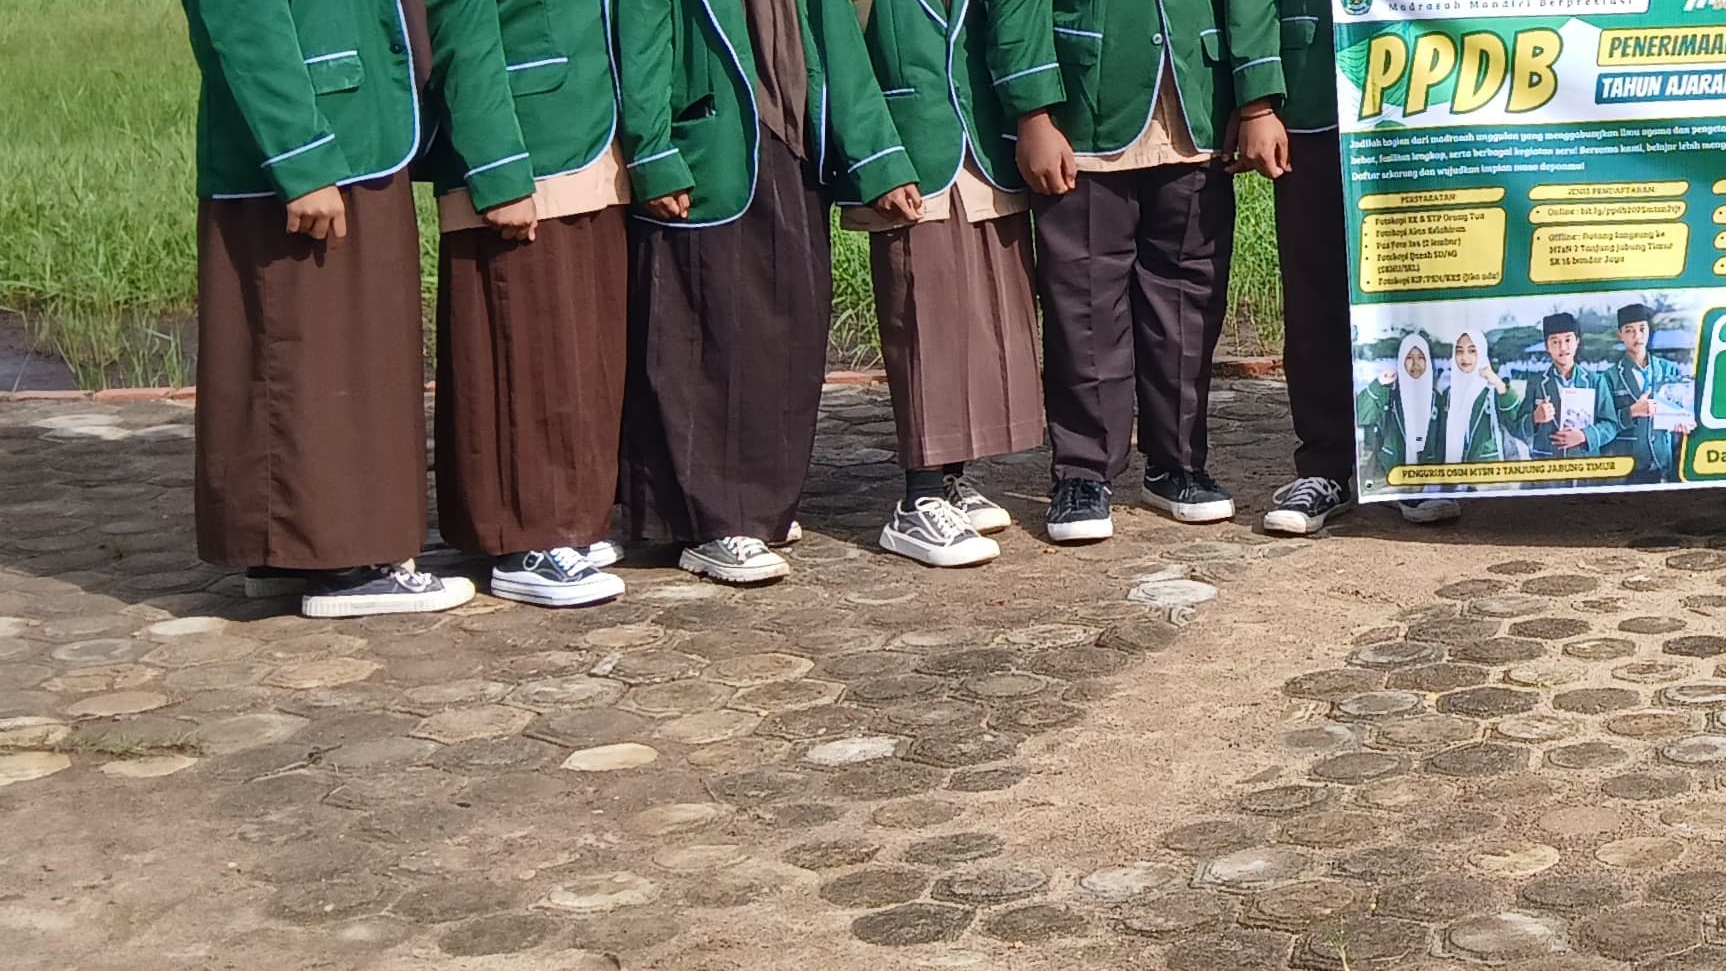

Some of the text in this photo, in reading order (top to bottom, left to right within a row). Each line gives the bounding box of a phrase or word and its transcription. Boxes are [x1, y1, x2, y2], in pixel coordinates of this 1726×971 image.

[1388, 0, 1461, 11] Madrasah
[1358, 27, 1563, 120] PPDB
[1602, 75, 1661, 101] TAHUN
[1350, 138, 1382, 149] Jadilah
[1410, 136, 1430, 146] dari
[1430, 134, 1474, 145] madrasah
[1476, 132, 1520, 145] unggulan
[1520, 133, 1543, 143] yang
[1544, 127, 1618, 142] menggabungkan
[1642, 127, 1672, 138] agama
[1672, 124, 1690, 134] dan
[1449, 149, 1472, 160] serta
[1472, 147, 1512, 161] berbagai
[1646, 140, 1677, 154] belajar
[1678, 139, 1700, 150] lebih
[1352, 169, 1380, 180] Daftar
[1382, 167, 1418, 181] sekarang
[1418, 166, 1434, 177] dan
[1436, 165, 1479, 178] wujudkan
[1480, 163, 1512, 177] impian
[1514, 164, 1538, 173] masa
[1469, 213, 1485, 221] Tua
[1402, 468, 1445, 479] PENGURUS
[1502, 464, 1545, 475] TANJUNG
[1547, 462, 1584, 473] JABUNG
[1586, 461, 1616, 472] TIMUR
